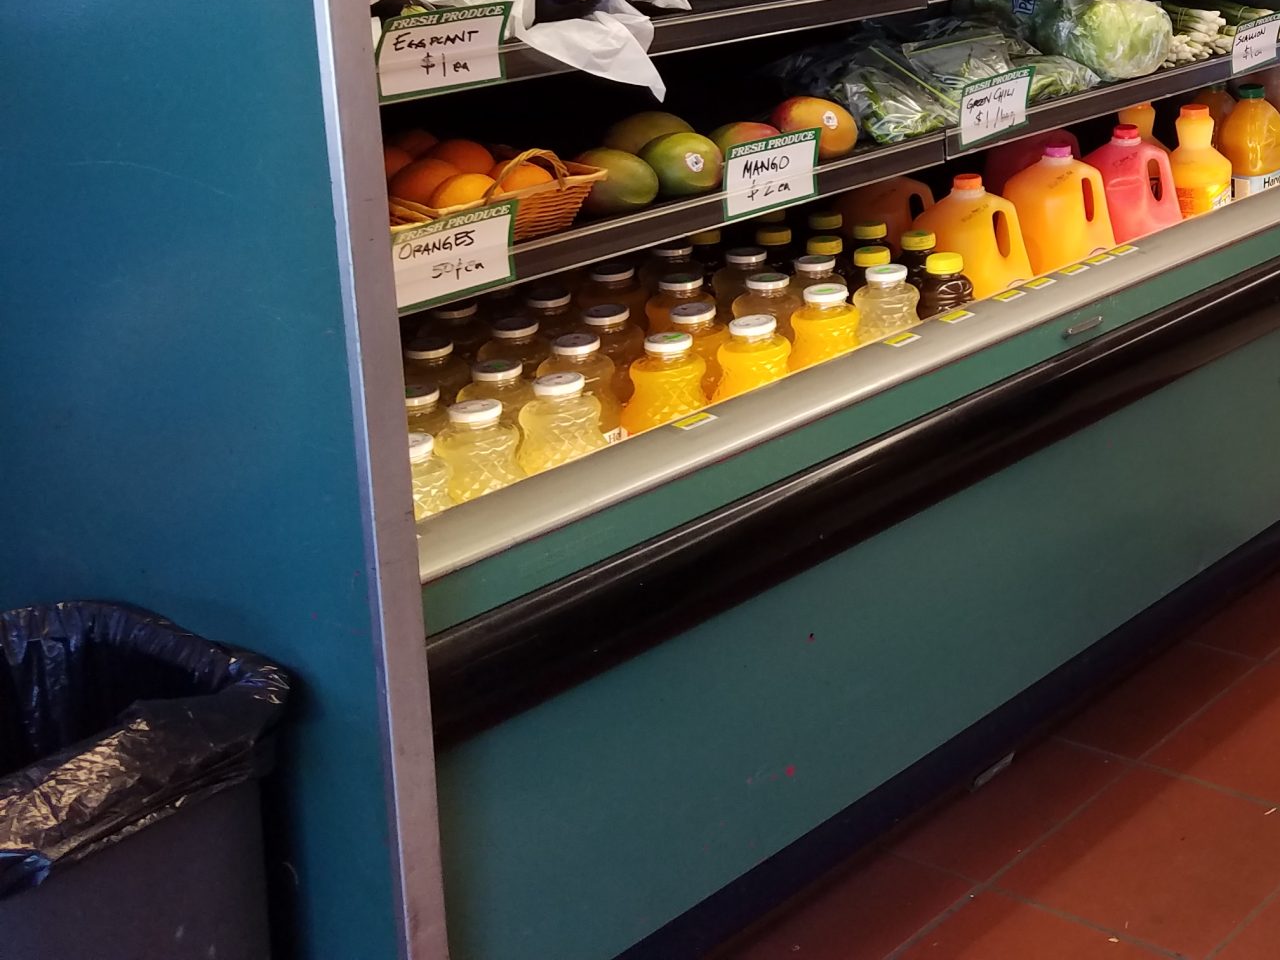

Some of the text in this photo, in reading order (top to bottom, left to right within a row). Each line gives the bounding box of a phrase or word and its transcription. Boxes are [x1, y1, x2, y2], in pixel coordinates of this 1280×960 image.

[390, 5, 505, 31] FRESH PRODUCE
[1237, 20, 1256, 34] FRESH
[964, 68, 1031, 96] FRESH PRODUCE
[730, 130, 815, 158] FRESH PRODUCE
[742, 155, 790, 180] MANGO
[398, 204, 511, 243] FRESH PRODUCE
[397, 229, 476, 260] ORANGES
